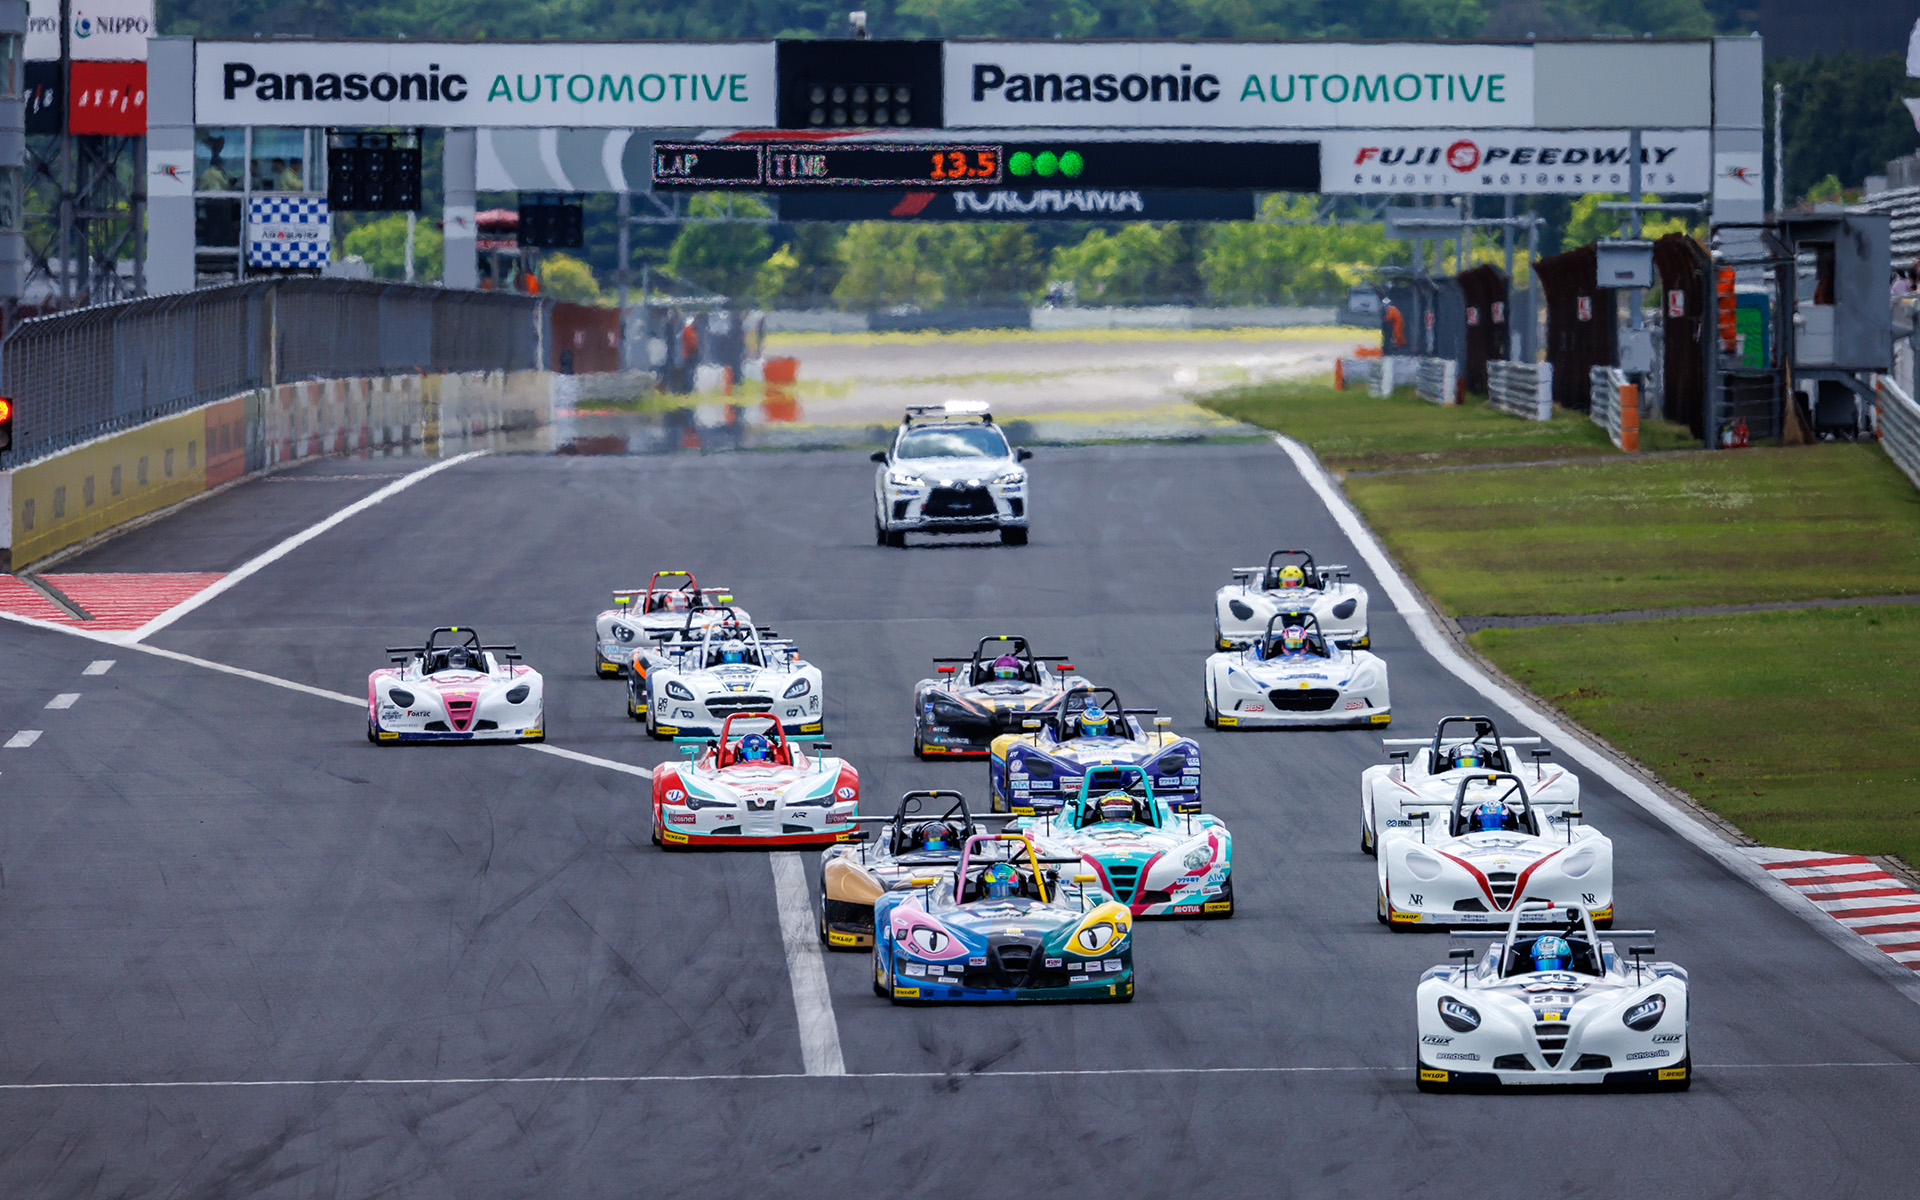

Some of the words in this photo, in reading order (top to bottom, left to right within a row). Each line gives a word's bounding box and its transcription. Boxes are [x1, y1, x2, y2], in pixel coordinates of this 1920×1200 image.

[96, 16, 149, 34] NIPPO
[223, 63, 468, 101] Panasonic
[487, 74, 749, 103] AUTOMOTIVE
[973, 65, 1220, 102] Panasonic
[1239, 74, 1505, 103] AUTOMOTIVE
[658, 154, 699, 176] LAP
[1354, 147, 1441, 165] FUJI
[774, 154, 827, 177] TIME
[931, 151, 996, 180] 13.5
[1482, 173, 1676, 185] MOTORSPOTS
[1408, 894, 1424, 906] NR
[1581, 893, 1597, 904] NR
[1173, 905, 1200, 913] MOTUL
